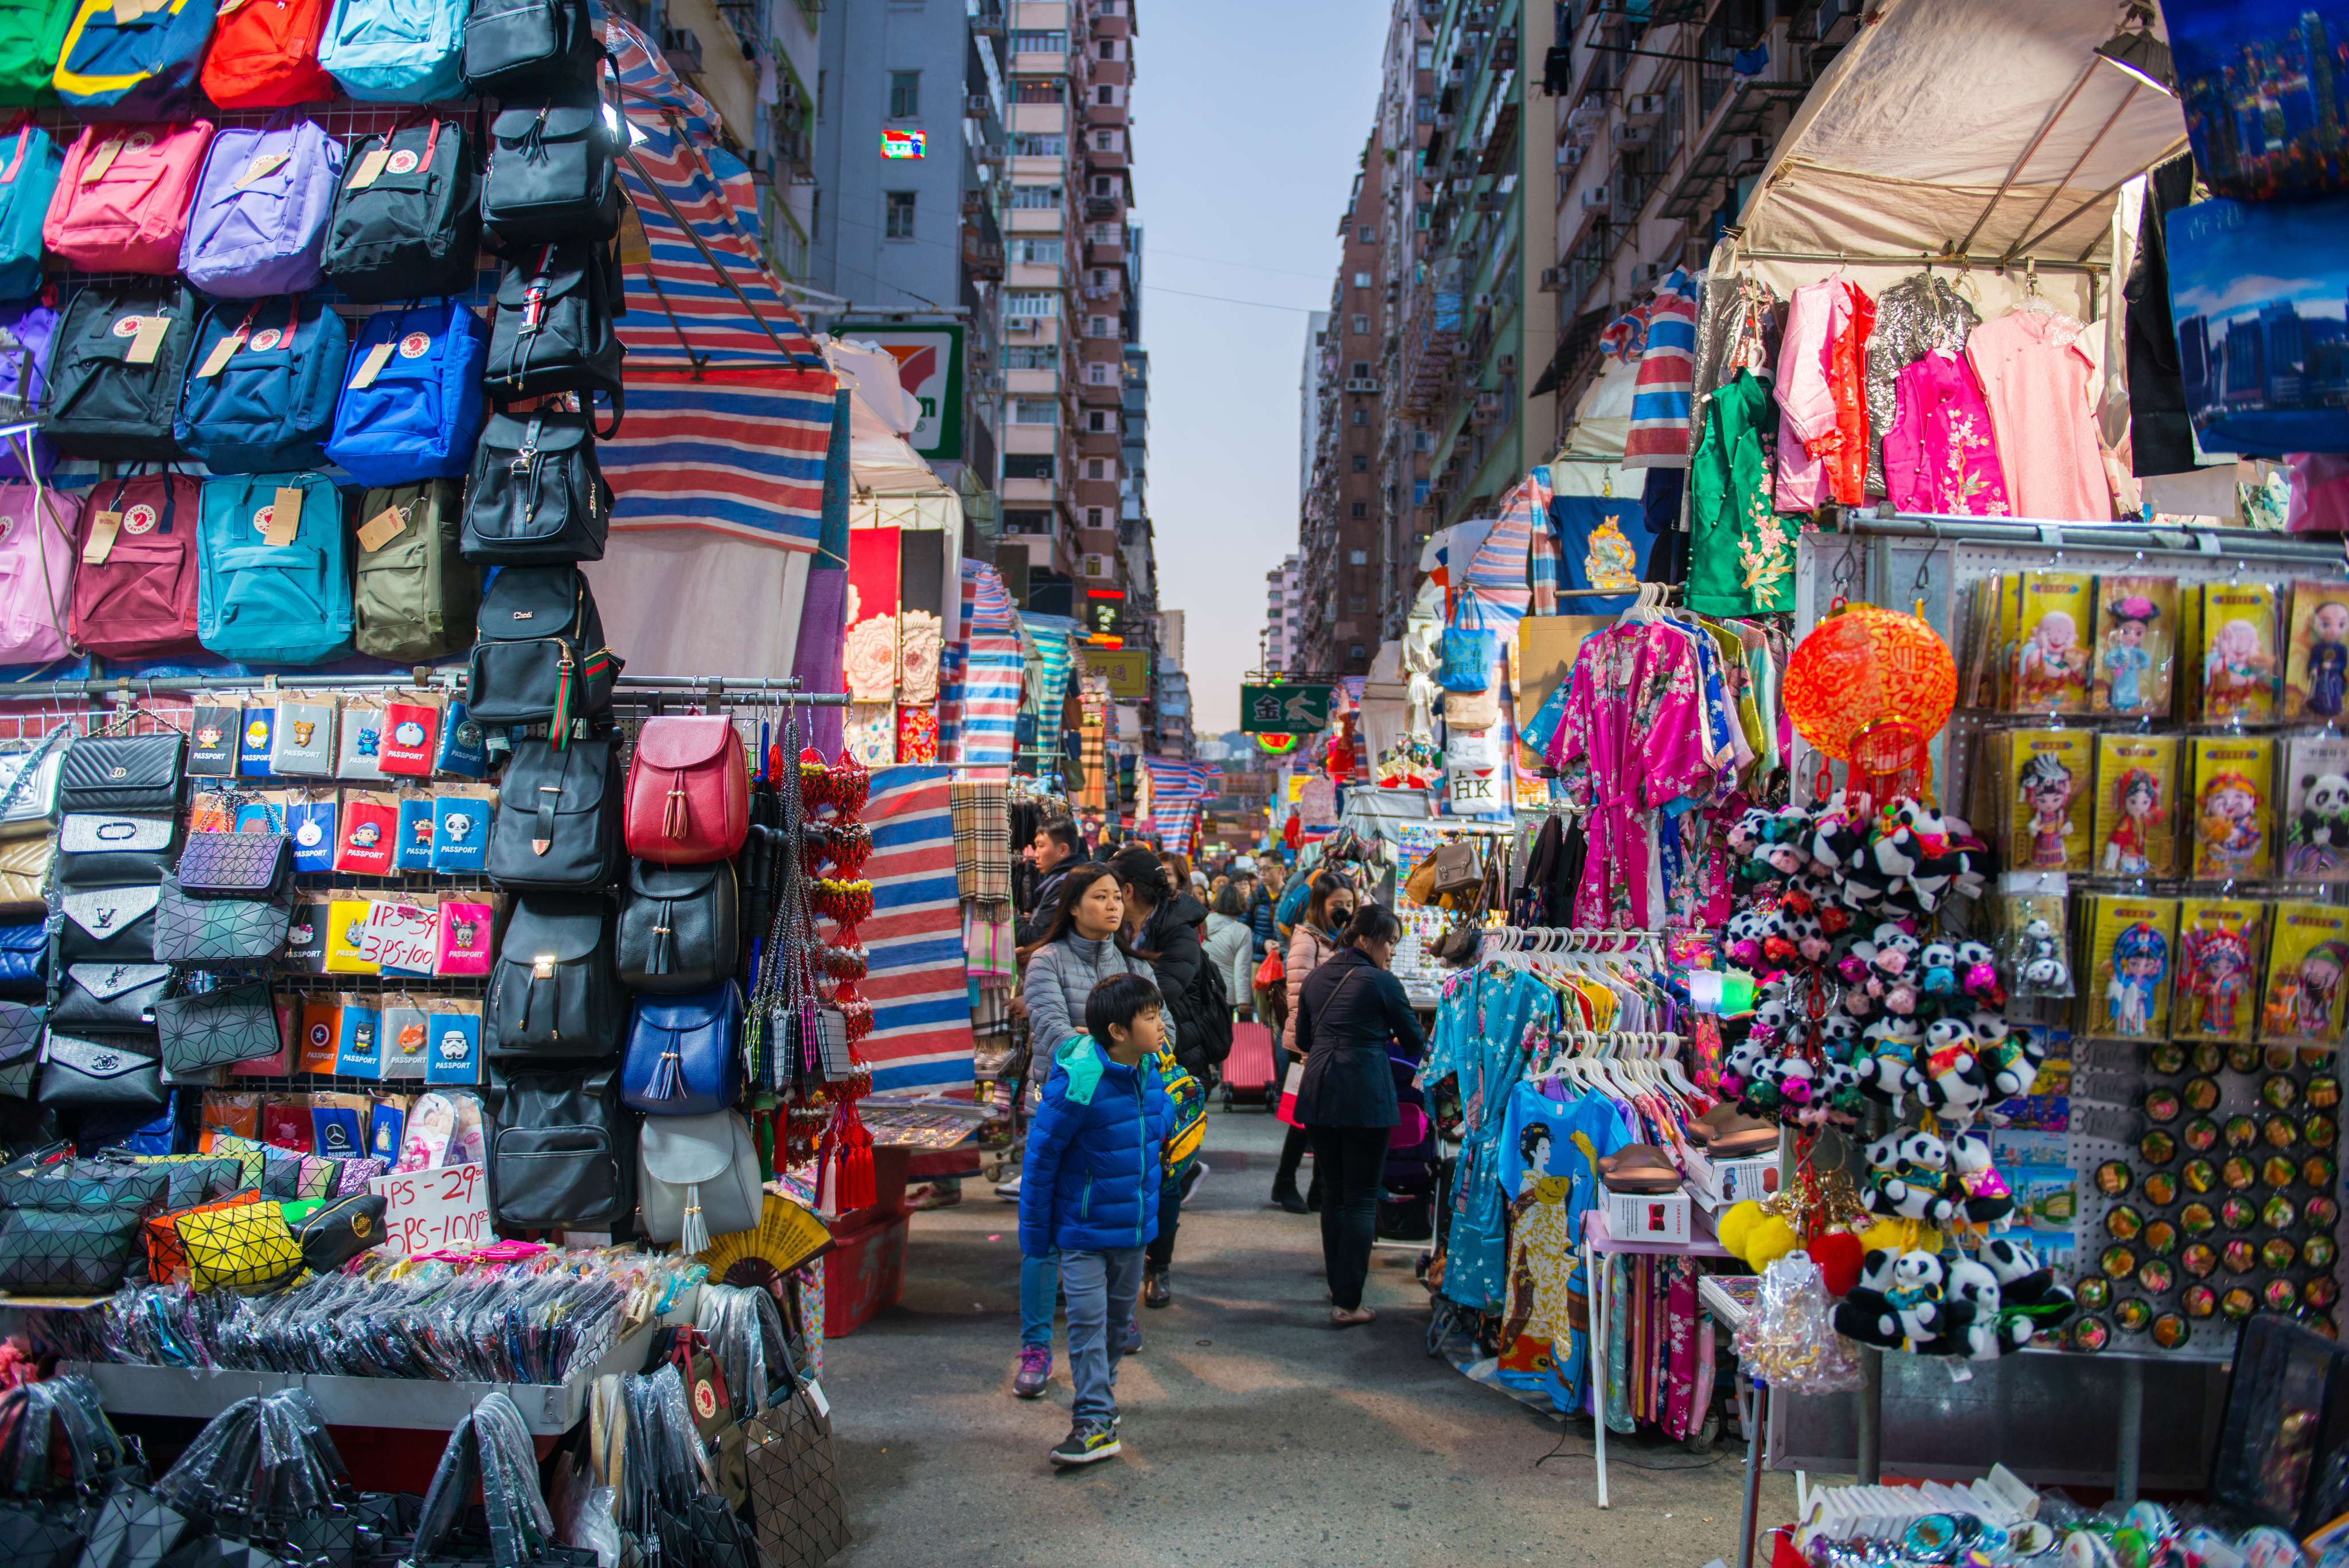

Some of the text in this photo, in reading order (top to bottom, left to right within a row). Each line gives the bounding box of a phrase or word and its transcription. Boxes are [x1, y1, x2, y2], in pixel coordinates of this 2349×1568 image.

[193, 752, 226, 760] PASSPORT
[283, 749, 321, 758] PASSPORT
[387, 750, 424, 760] PASSPORT
[451, 749, 482, 763] PASSPORT
[1453, 779, 1493, 801] HK
[293, 849, 327, 858] PASSPORT
[346, 848, 384, 860] PASSPORT
[441, 845, 478, 855] PASSPORT
[284, 950, 322, 958] PASSPORT
[336, 949, 360, 957] PASSP
[448, 950, 485, 958] PASSPORT
[307, 1051, 335, 1060] PASSPORT
[343, 1054, 377, 1065] PASSPORT
[391, 1056, 427, 1065] PASSPORT
[435, 1062, 471, 1070] PASSPORT
